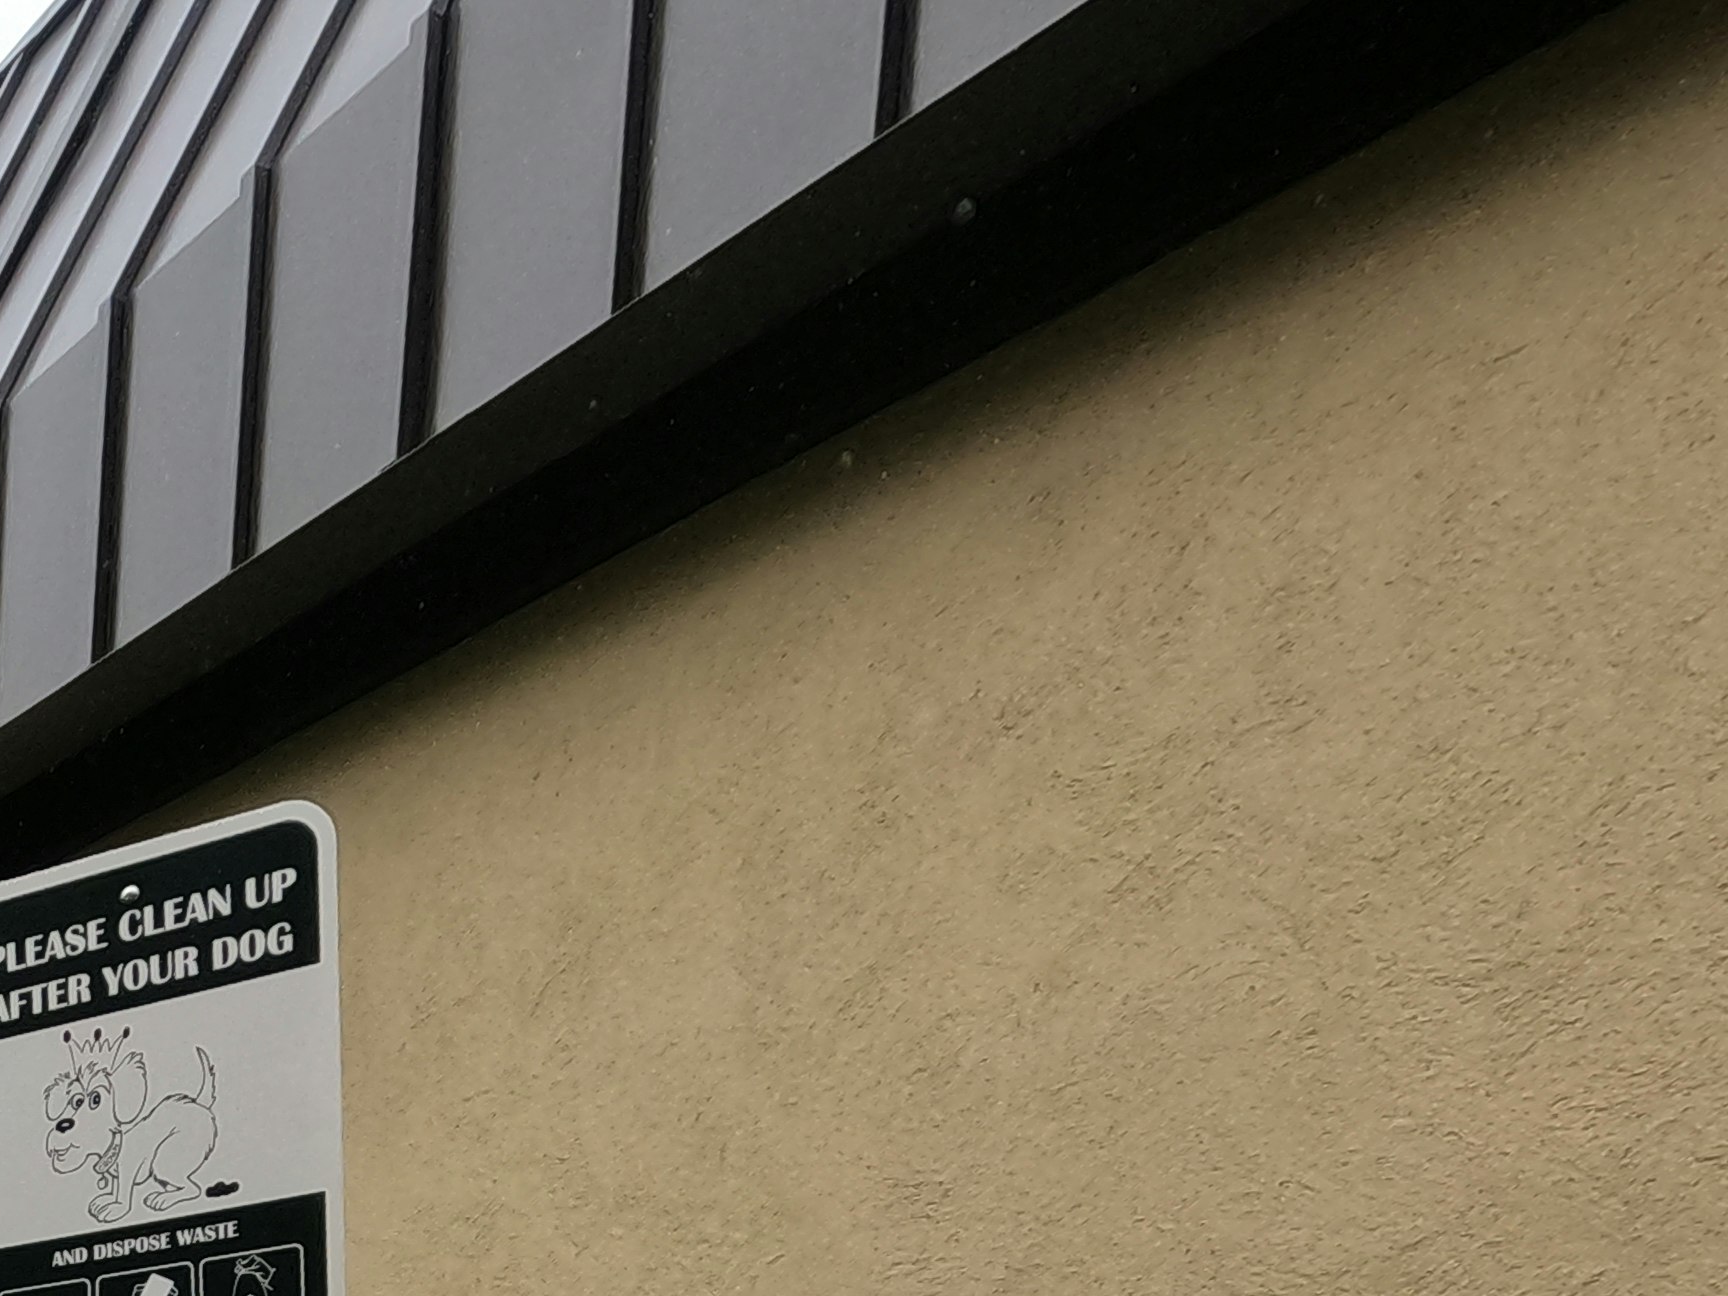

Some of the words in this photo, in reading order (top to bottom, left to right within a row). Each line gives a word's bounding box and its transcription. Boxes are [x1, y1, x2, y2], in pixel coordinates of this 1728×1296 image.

[118, 884, 232, 942] CLEAN
[244, 867, 297, 909] UP
[102, 946, 199, 997] YOUR
[211, 922, 294, 971] DOG
[51, 1247, 89, 1267] AND
[93, 1232, 171, 1260] DISPOSE
[176, 1220, 240, 1246] WASTE
